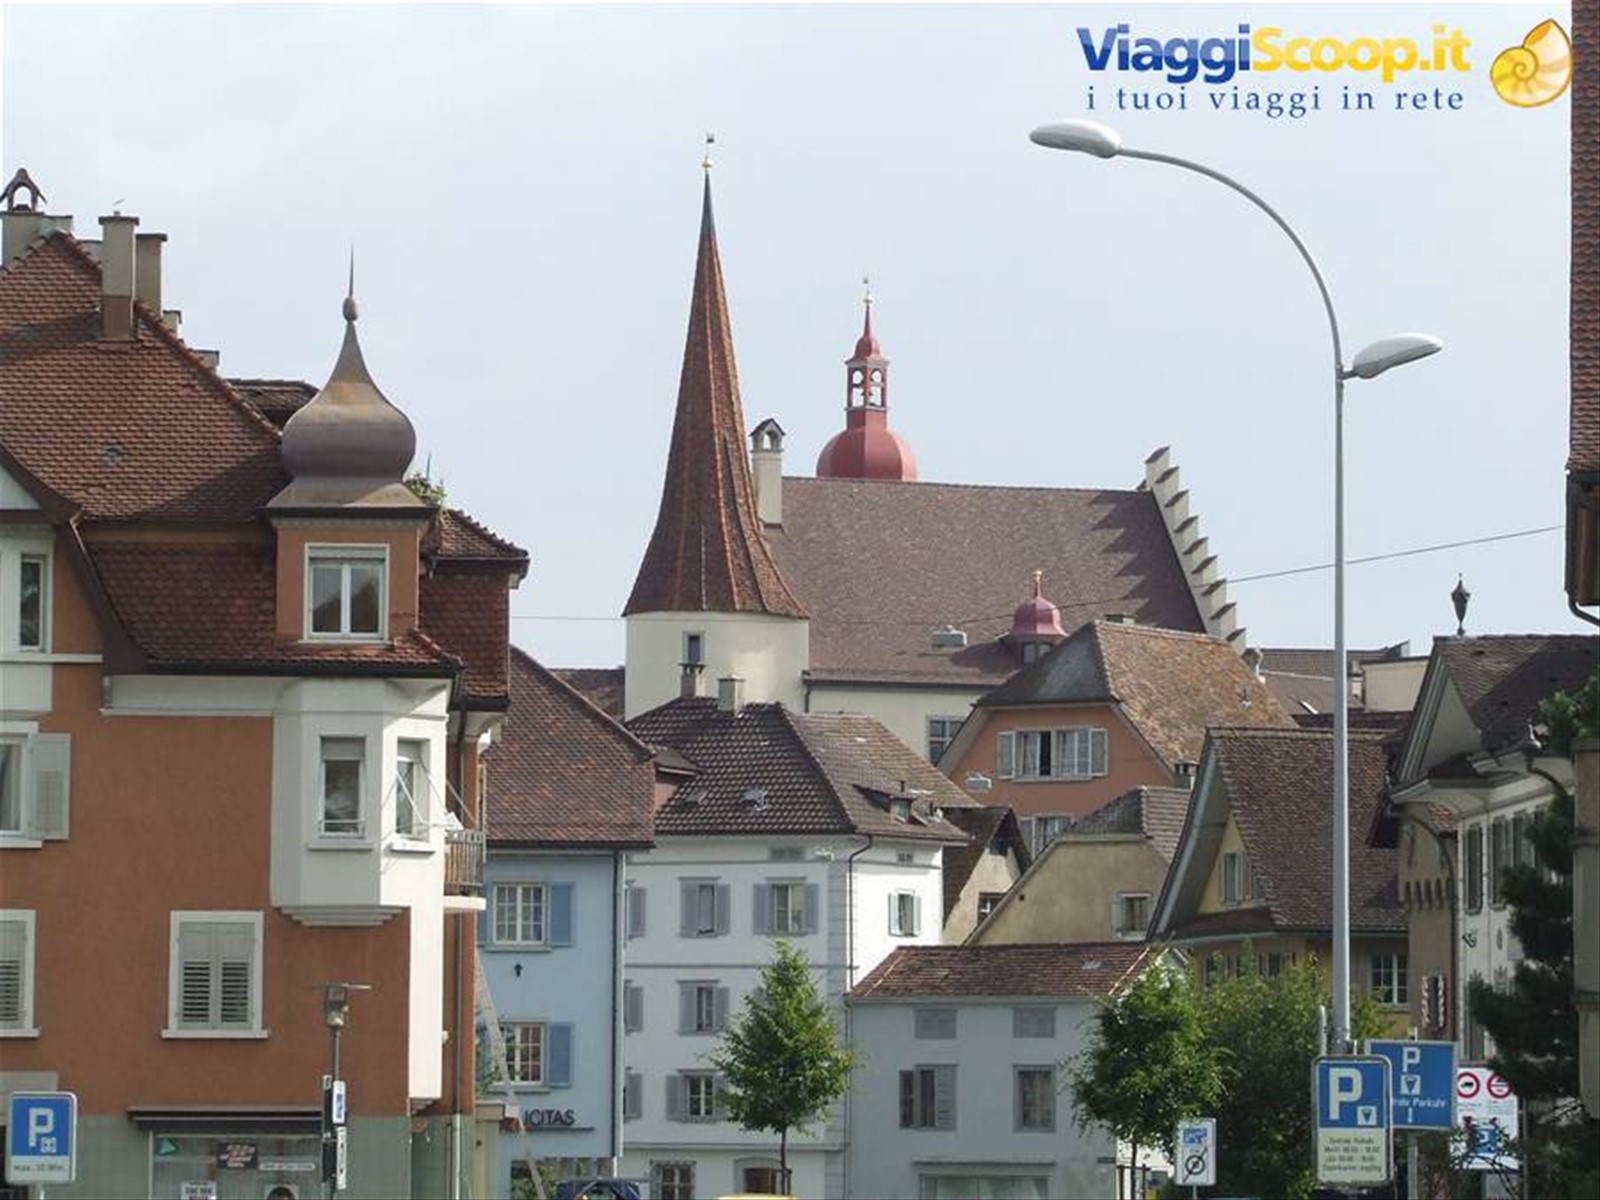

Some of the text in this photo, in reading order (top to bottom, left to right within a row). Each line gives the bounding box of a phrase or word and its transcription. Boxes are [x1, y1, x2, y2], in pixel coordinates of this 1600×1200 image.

[1402, 1046, 1420, 1073] P
[1329, 1067, 1363, 1121] P
[28, 1107, 55, 1148] P
